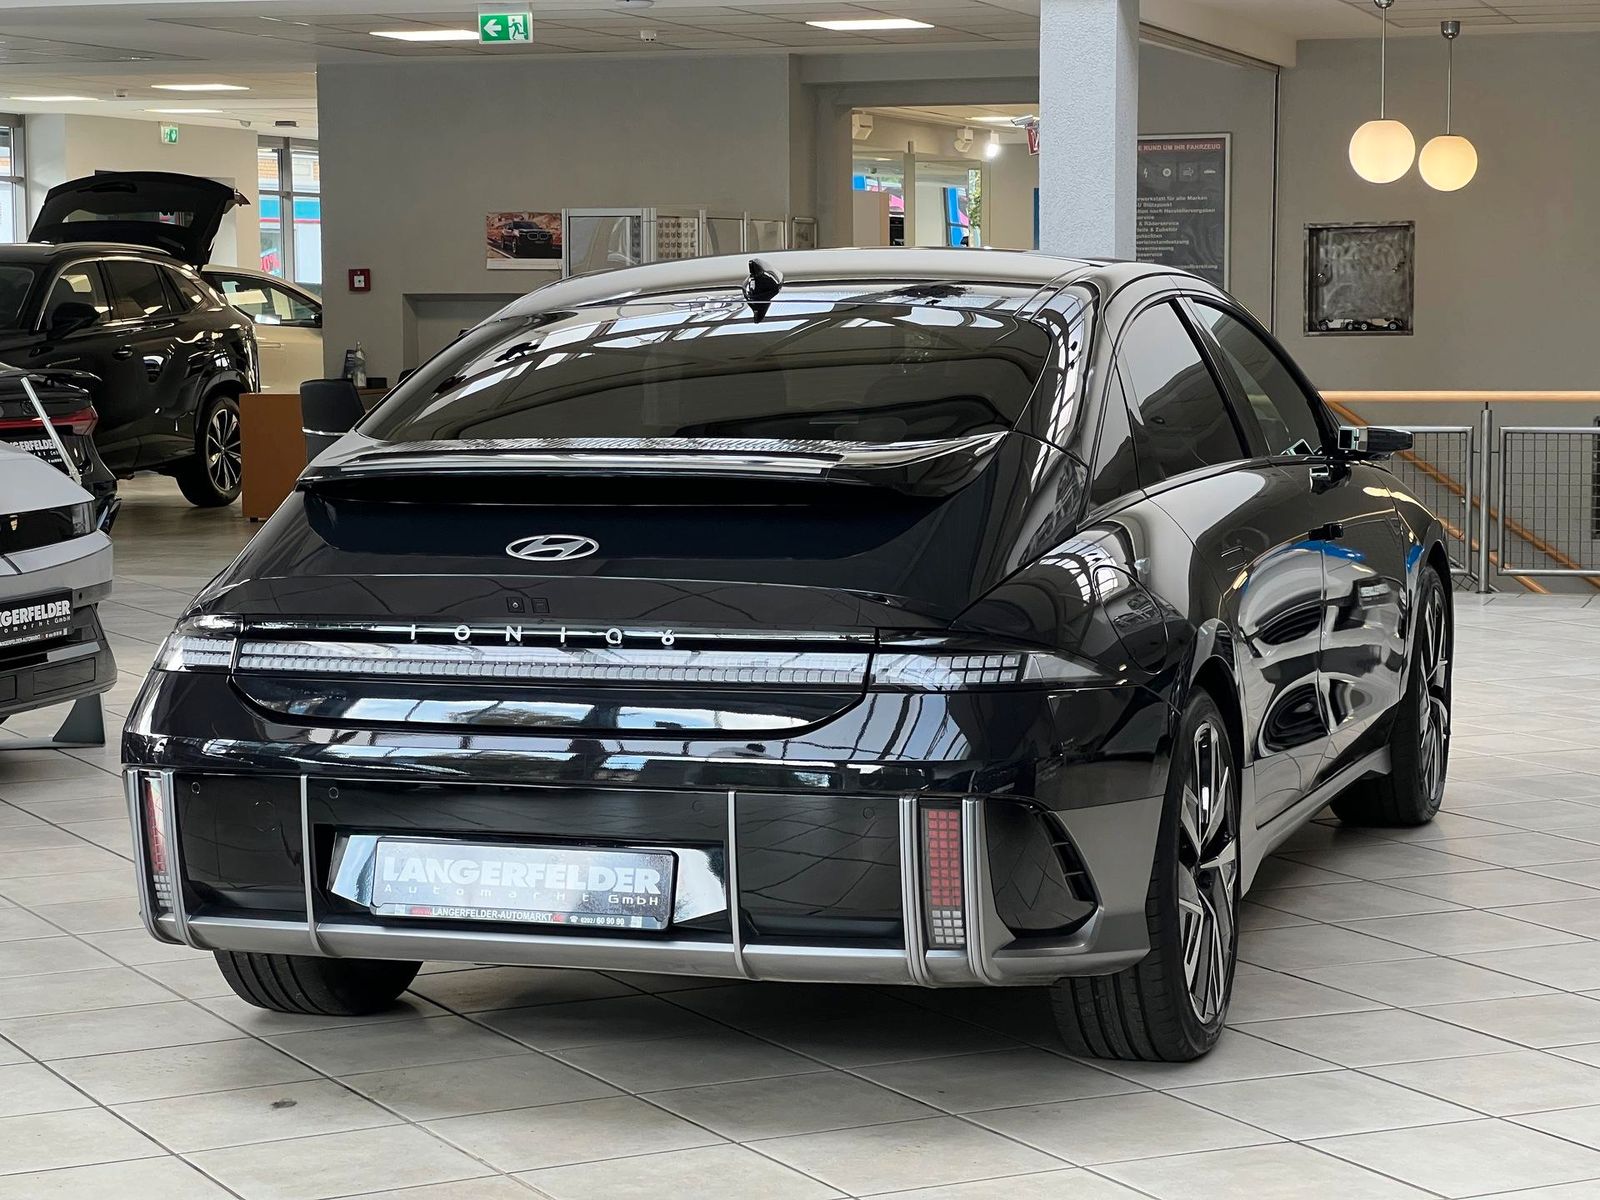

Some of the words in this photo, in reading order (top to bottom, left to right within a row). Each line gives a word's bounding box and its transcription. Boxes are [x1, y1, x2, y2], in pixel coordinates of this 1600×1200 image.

[1186, 143, 1221, 151] FAHRZEUG
[660, 628, 675, 646] 6
[382, 856, 661, 894] LANGERFELDER
[607, 894, 659, 906] GmbH
